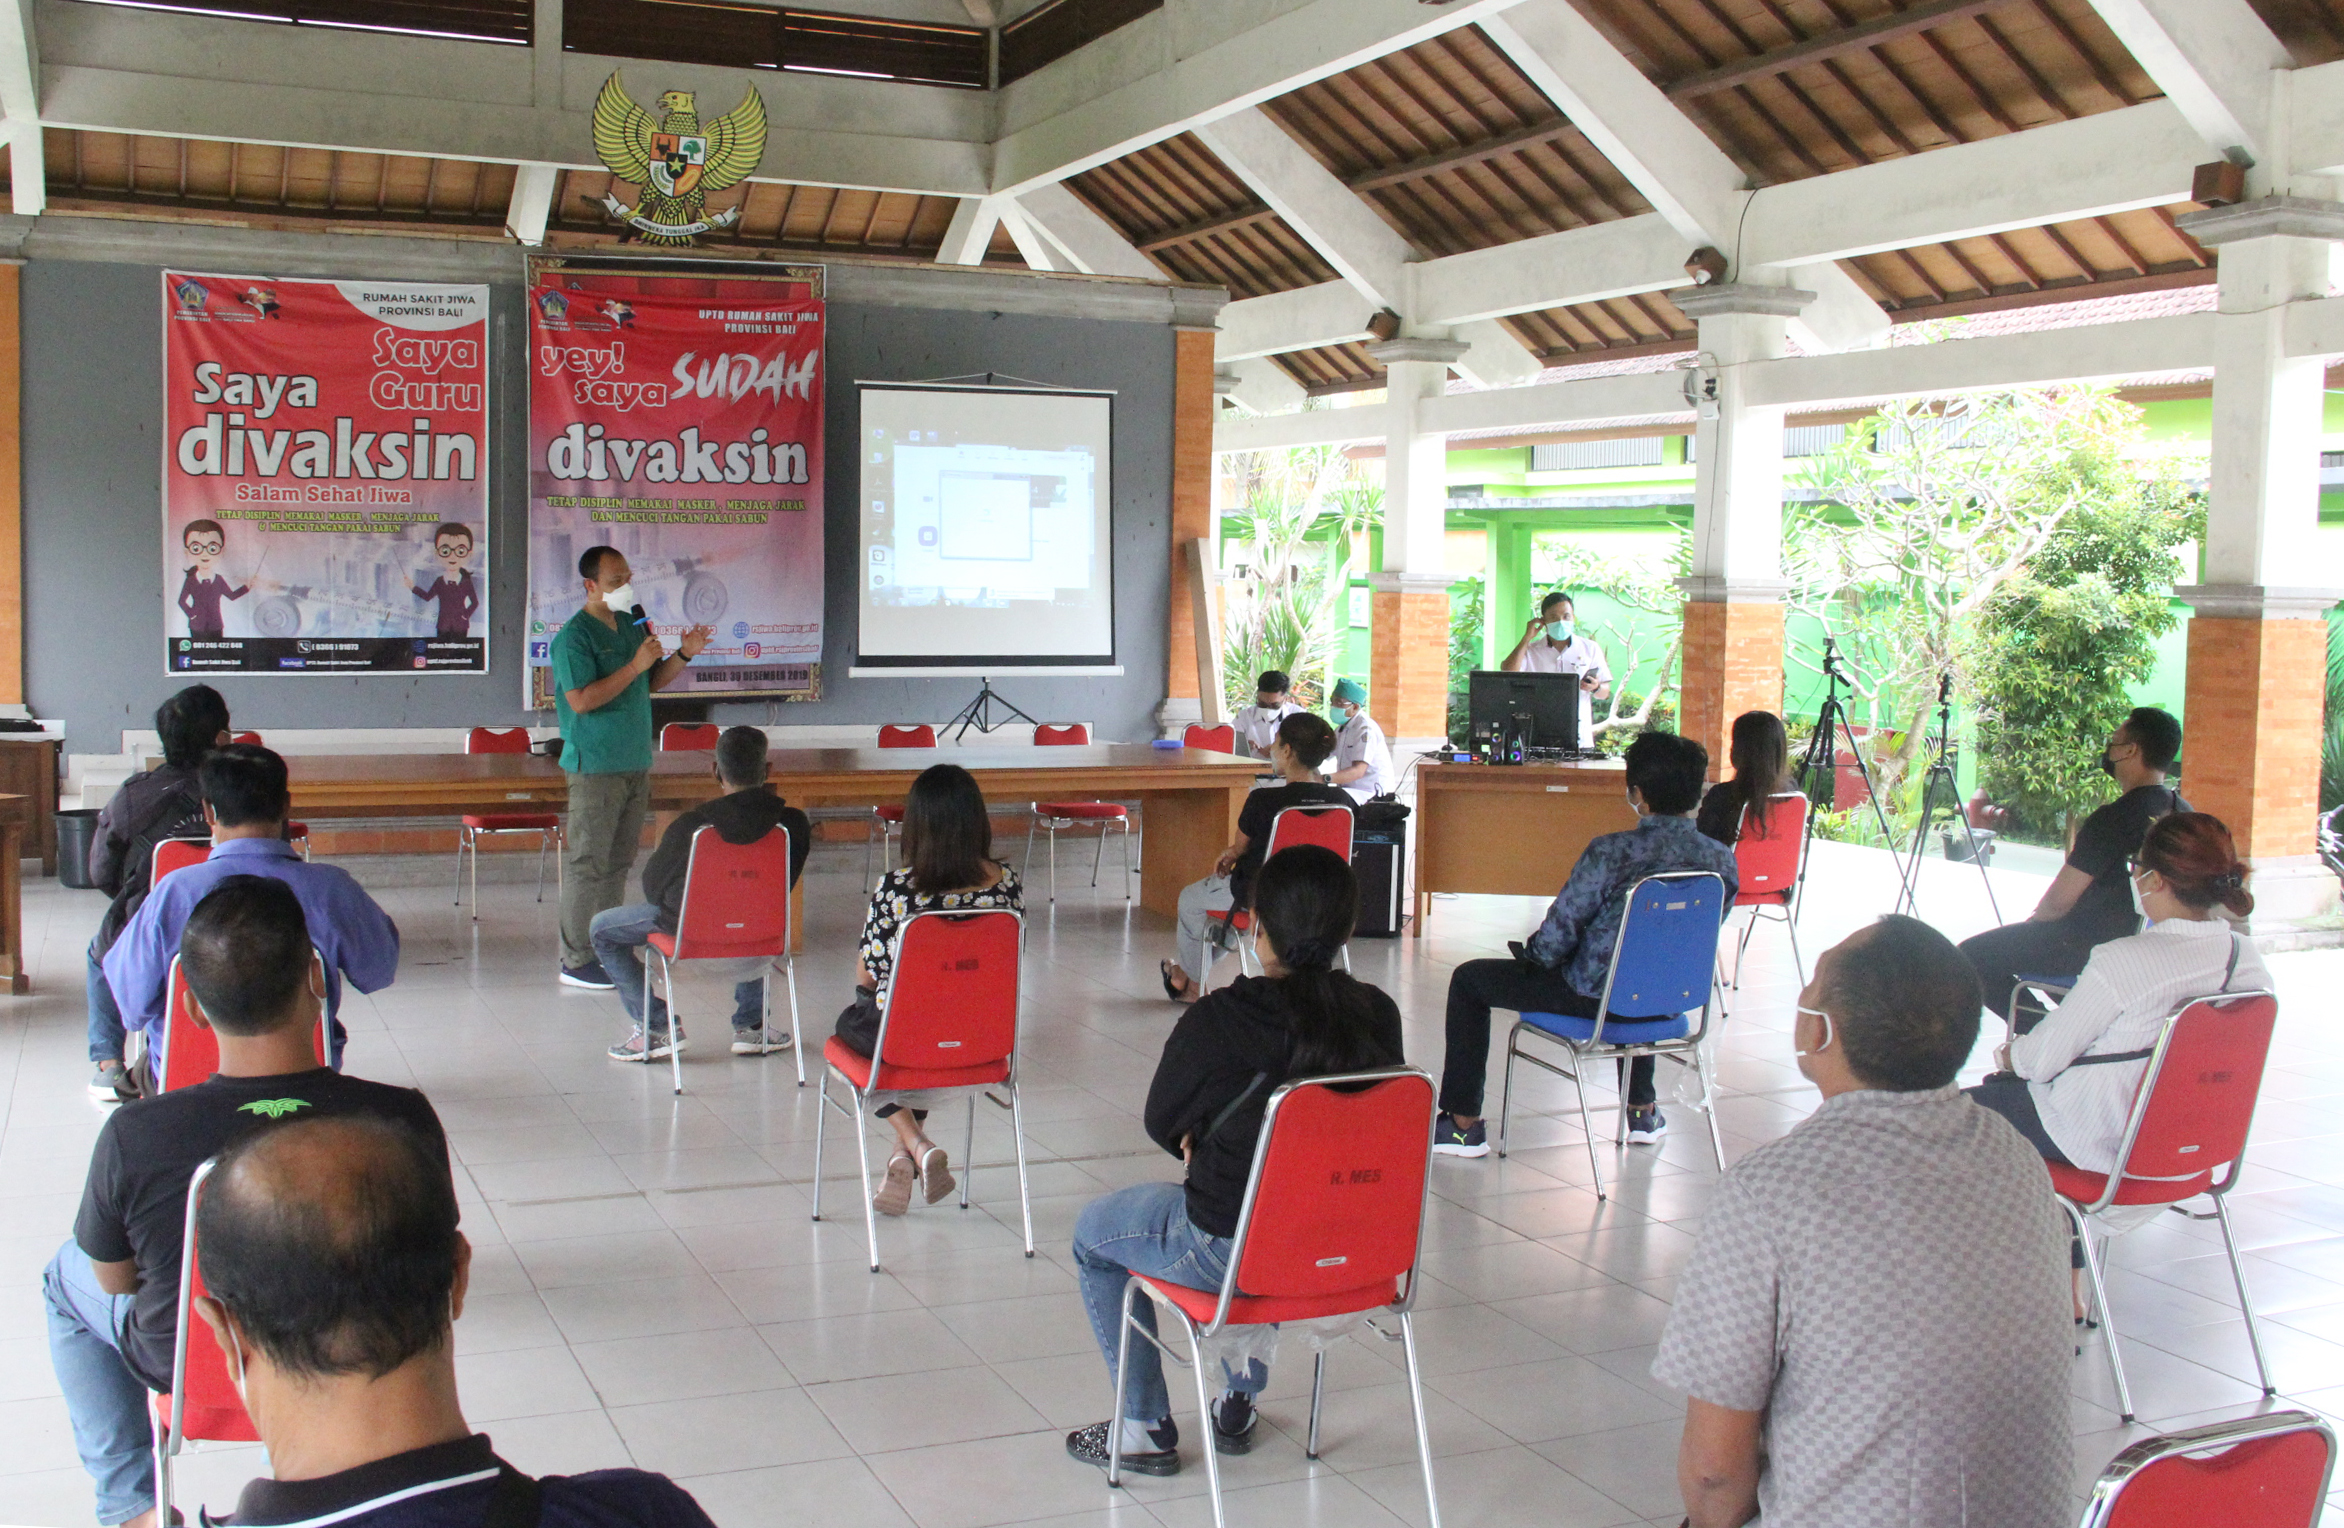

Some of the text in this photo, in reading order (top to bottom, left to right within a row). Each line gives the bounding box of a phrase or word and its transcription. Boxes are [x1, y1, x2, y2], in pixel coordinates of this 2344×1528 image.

[363, 293, 476, 305] RUMAH SAKIT JIWA
[379, 306, 463, 317] PROVINSI BALI
[699, 309, 724, 319] UPTD
[727, 310, 762, 321] RUMAH
[765, 311, 793, 322] SAKIT
[724, 323, 796, 334] PROVINSI BALI
[372, 326, 477, 375] Saya
[541, 341, 625, 379] yey!
[670, 348, 820, 408] SUDAH
[193, 361, 318, 419] Saya
[369, 370, 481, 412] Guru
[177, 412, 477, 481] divaksin
[546, 421, 810, 484] divaksin
[235, 483, 413, 505] Salam Sehat Jiwa
[547, 495, 578, 507] TETAP
[580, 497, 622, 509] DISIPLIN
[627, 498, 673, 510] MEMAKAI
[677, 499, 716, 510] MASKER
[727, 500, 773, 511] MENJAGA
[775, 500, 806, 511] JARAK
[216, 510, 243, 519] TETAP
[244, 510, 281, 520] DISIPLIN
[284, 511, 325, 521] MEMAKAI
[328, 512, 362, 521] MASKER
[370, 513, 410, 522] MENJAGA
[412, 513, 440, 522] JARAK
[591, 510, 768, 524] DAN MENCUCI TANGAN PAKAI SABUN
[258, 522, 401, 533] & MENCUCI TANGAN PAKAI SABUN
[730, 671, 741, 682] 30
[742, 670, 786, 682] DESEMBER
[1330, 1169, 1382, 1185] R. MES
